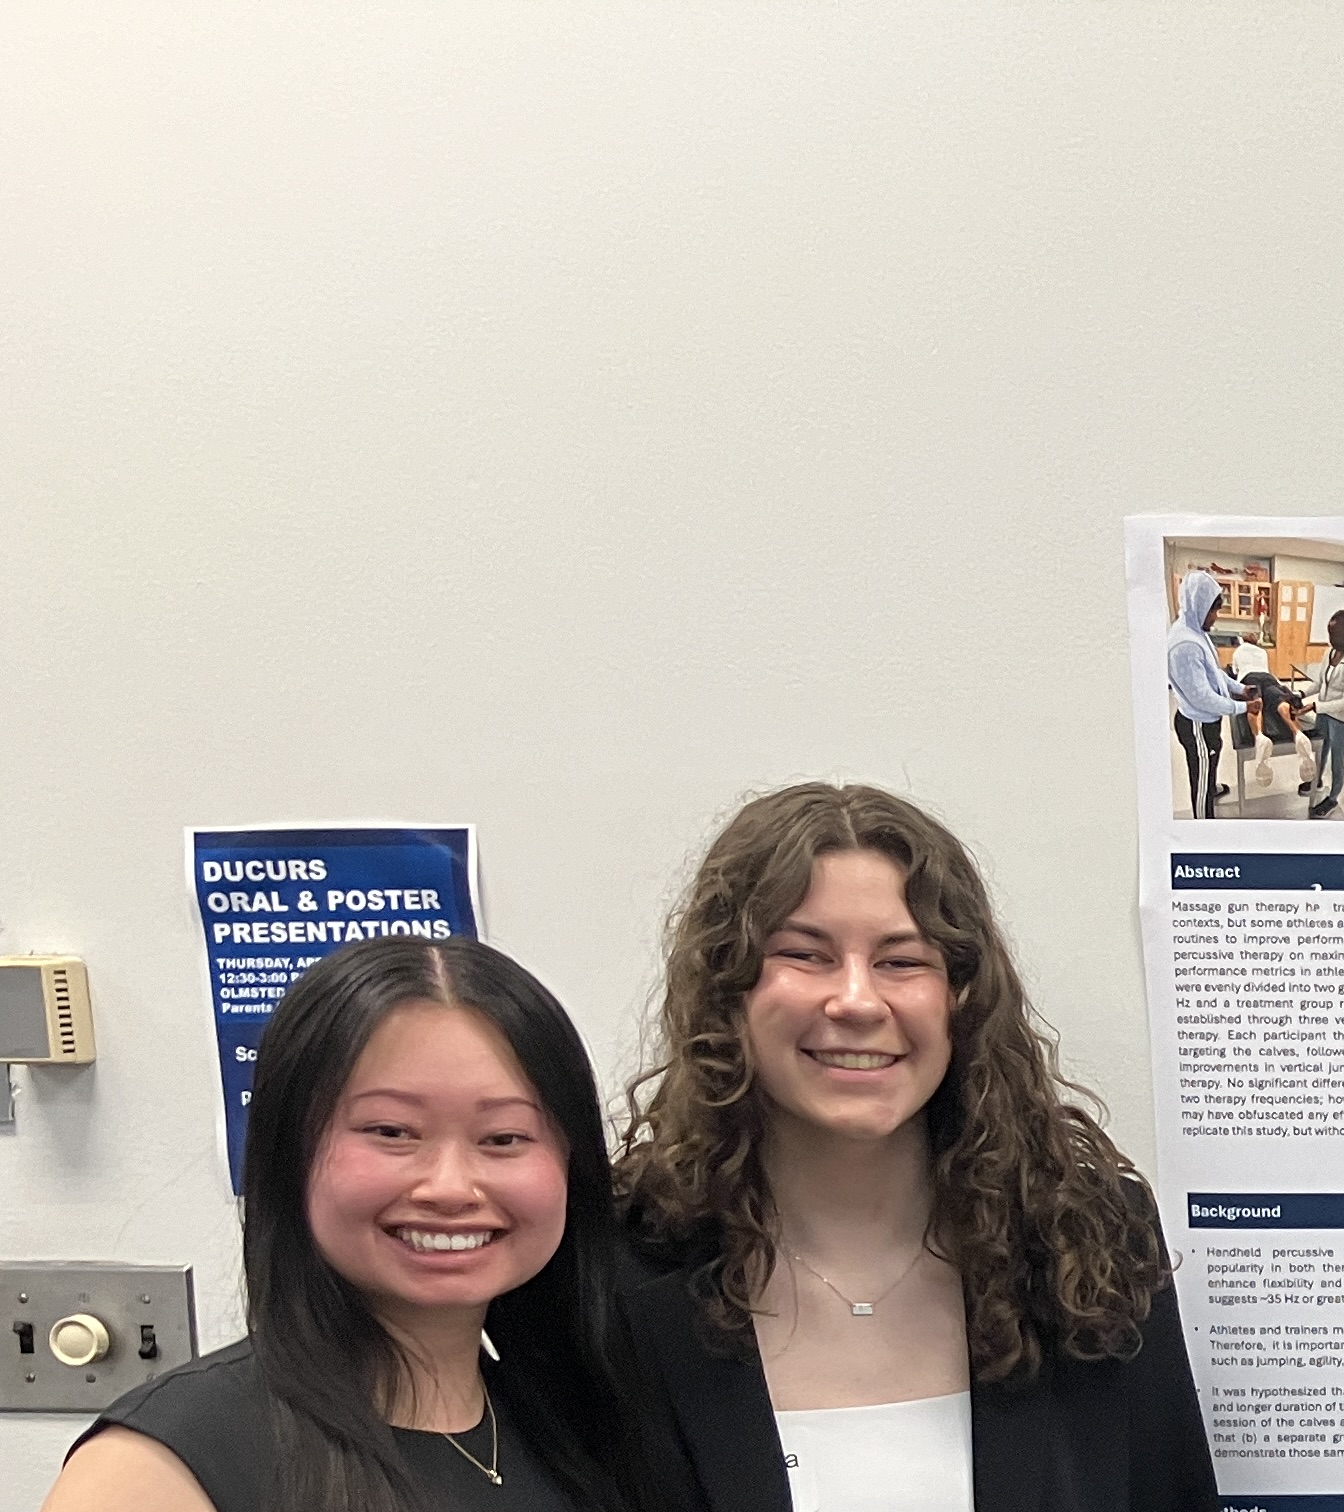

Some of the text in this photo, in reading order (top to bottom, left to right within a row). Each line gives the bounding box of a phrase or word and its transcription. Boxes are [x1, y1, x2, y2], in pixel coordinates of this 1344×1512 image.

[201, 859, 327, 882] DUCURS
[1174, 864, 1240, 878] Abstract
[207, 889, 440, 913] ORAL & POSTER
[213, 919, 451, 943] PRESENTATIONS
[216, 957, 293, 970] THURSDAY,
[219, 972, 287, 984] 12:30-3:00
[220, 987, 286, 999] OLMSTED
[222, 1002, 273, 1014] Parents
[1182, 1125, 1229, 1137] replicate
[1231, 1125, 1253, 1136] this
[1292, 1125, 1312, 1136] but
[1191, 1204, 1280, 1220] Background
